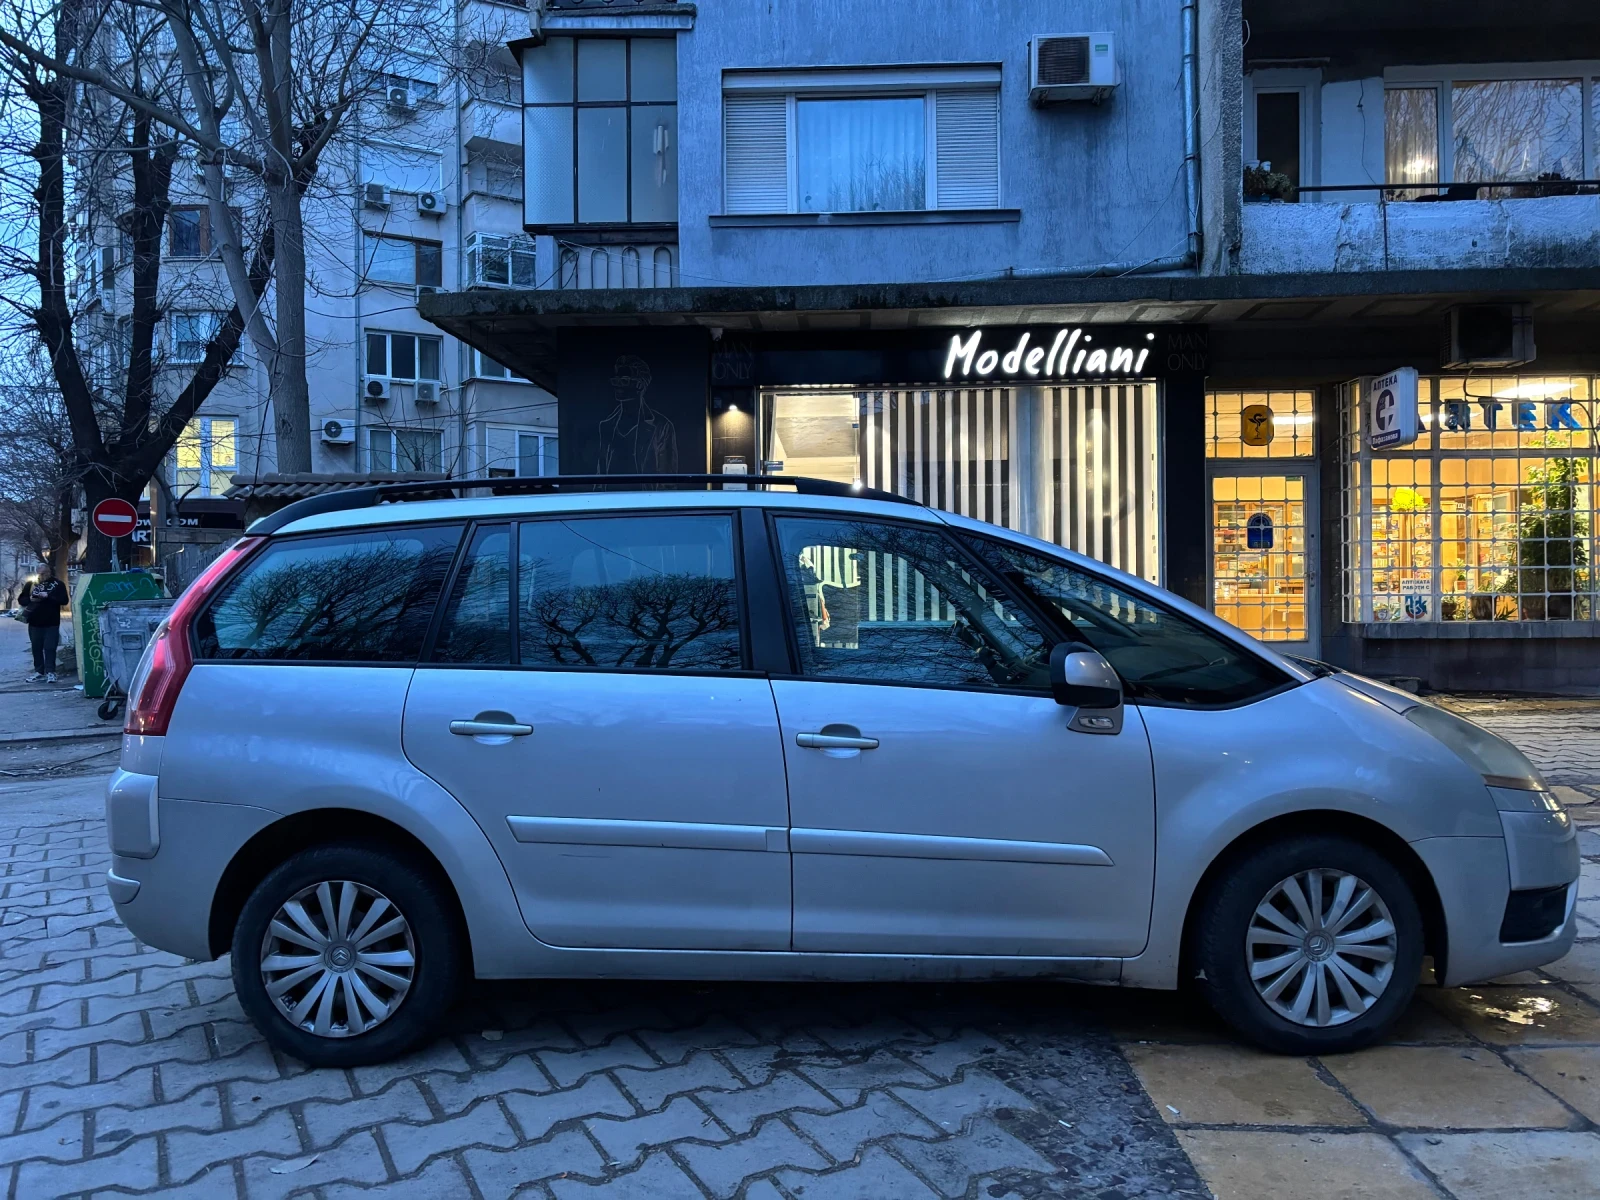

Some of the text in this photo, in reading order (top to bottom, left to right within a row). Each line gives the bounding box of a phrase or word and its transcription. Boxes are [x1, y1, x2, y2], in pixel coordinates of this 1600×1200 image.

[1168, 332, 1208, 350] MAN
[944, 328, 1155, 378] Modelliani
[1168, 353, 1208, 371] ONLY
[712, 361, 753, 380] ONLY
[1373, 374, 1398, 391] АПТЕКА
